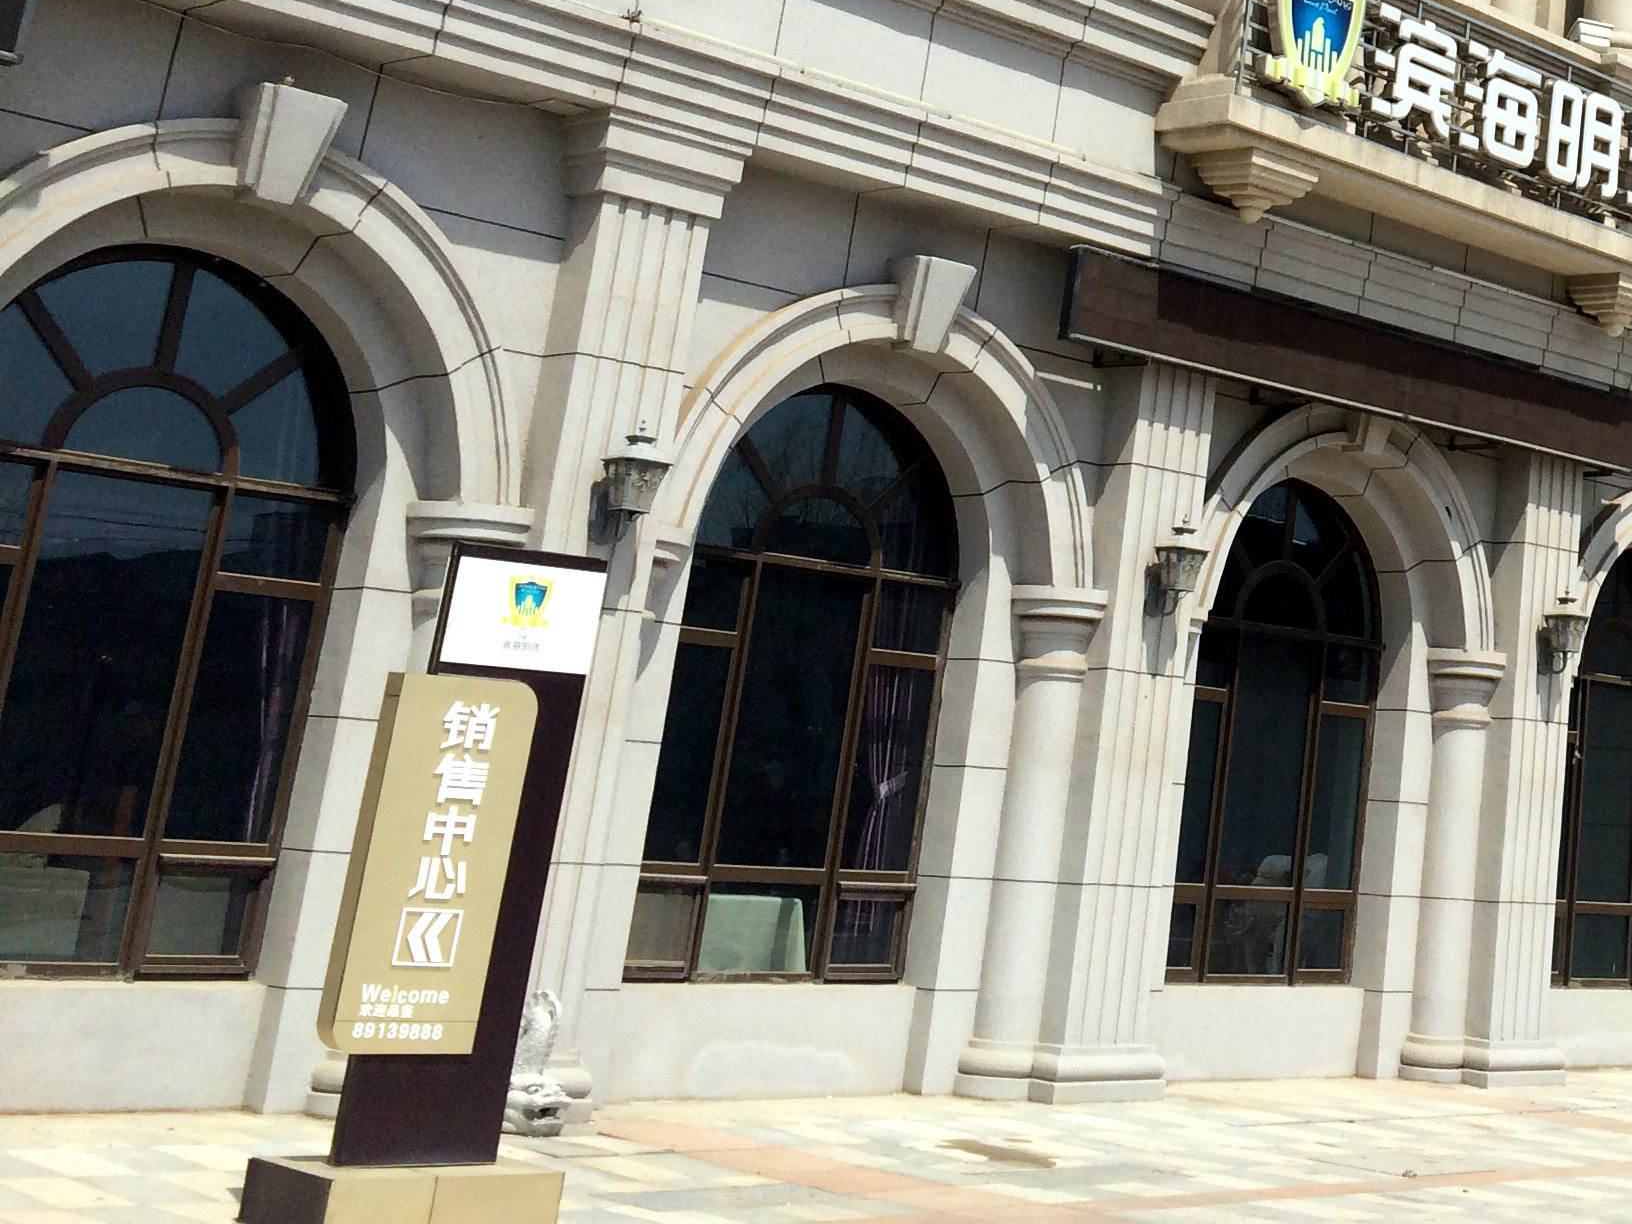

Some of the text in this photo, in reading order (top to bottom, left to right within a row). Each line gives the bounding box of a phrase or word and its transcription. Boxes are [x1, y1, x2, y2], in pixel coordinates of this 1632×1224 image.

[407, 701, 500, 901] 销售中心
[361, 983, 450, 1005] Welcome
[352, 1022, 444, 1041] 89139888
